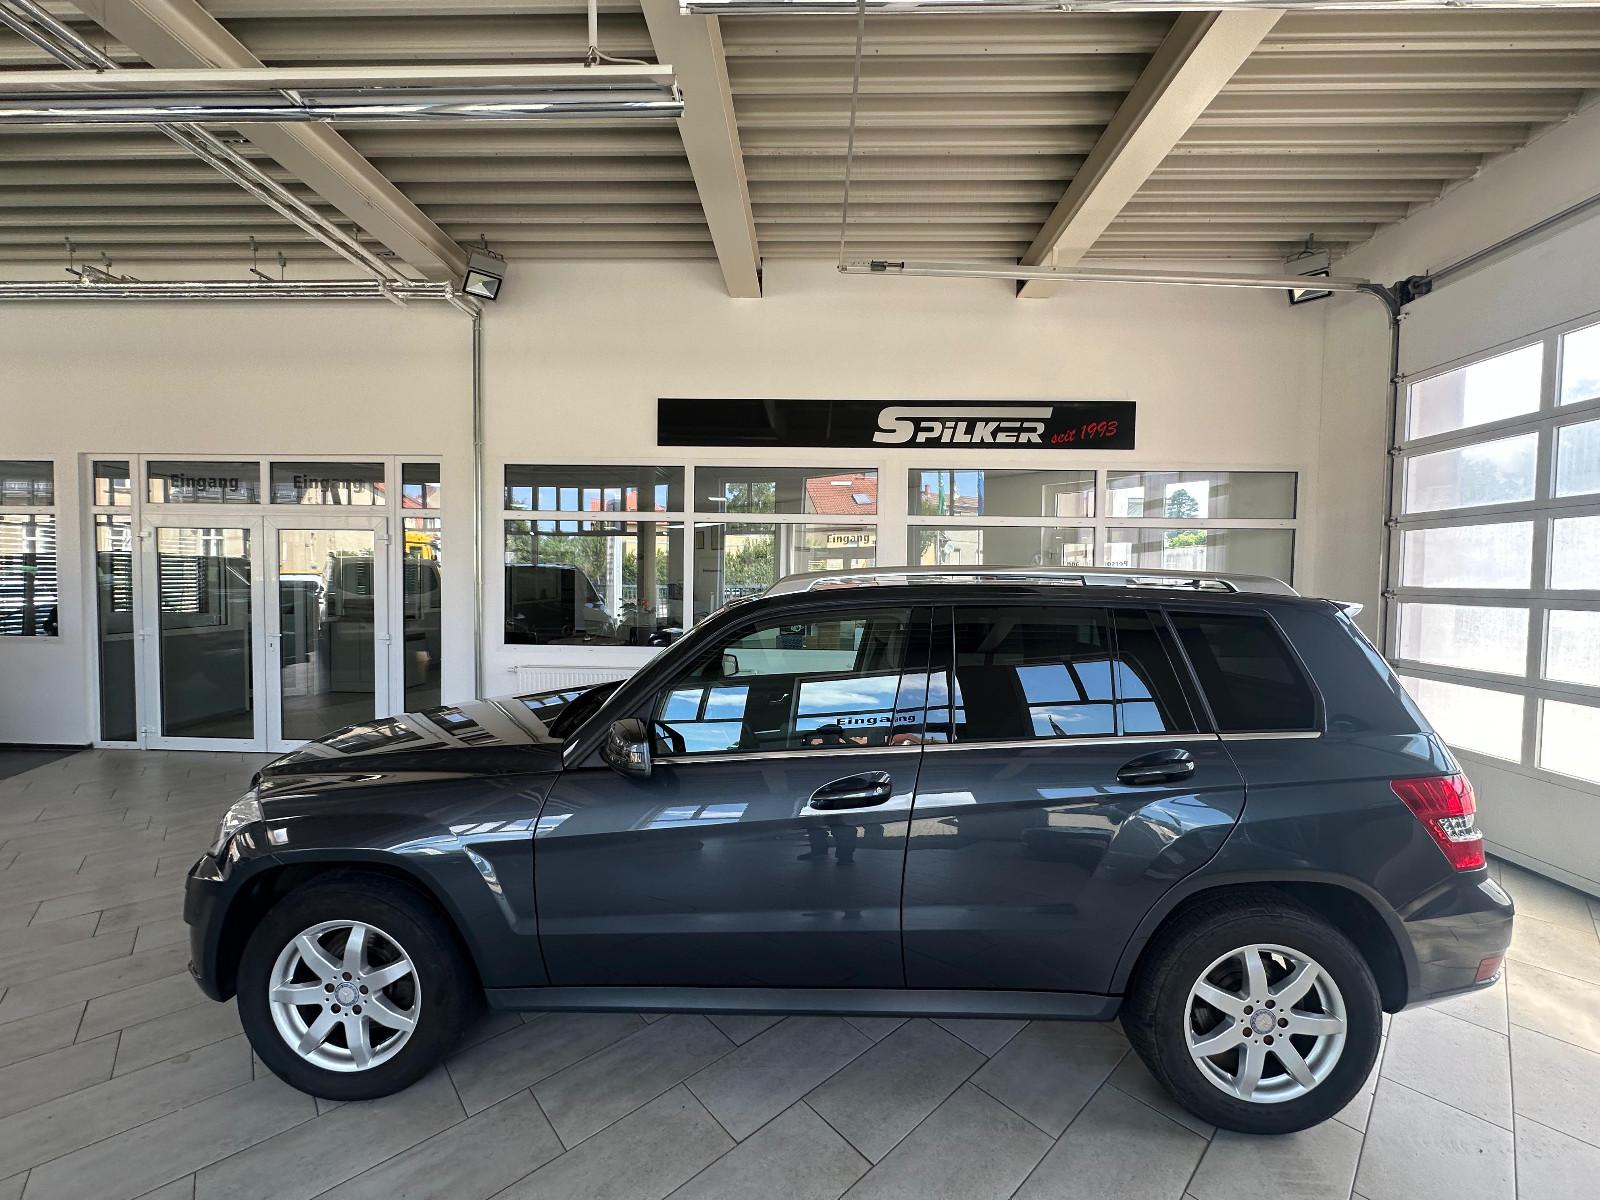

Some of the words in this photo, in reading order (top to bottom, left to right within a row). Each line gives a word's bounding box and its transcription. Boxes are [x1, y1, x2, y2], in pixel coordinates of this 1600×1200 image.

[1051, 428, 1076, 444] seit
[1079, 420, 1119, 441] 1993
[170, 473, 239, 492] Eingang
[293, 475, 366, 494] Eingang
[826, 534, 870, 545] Eingang
